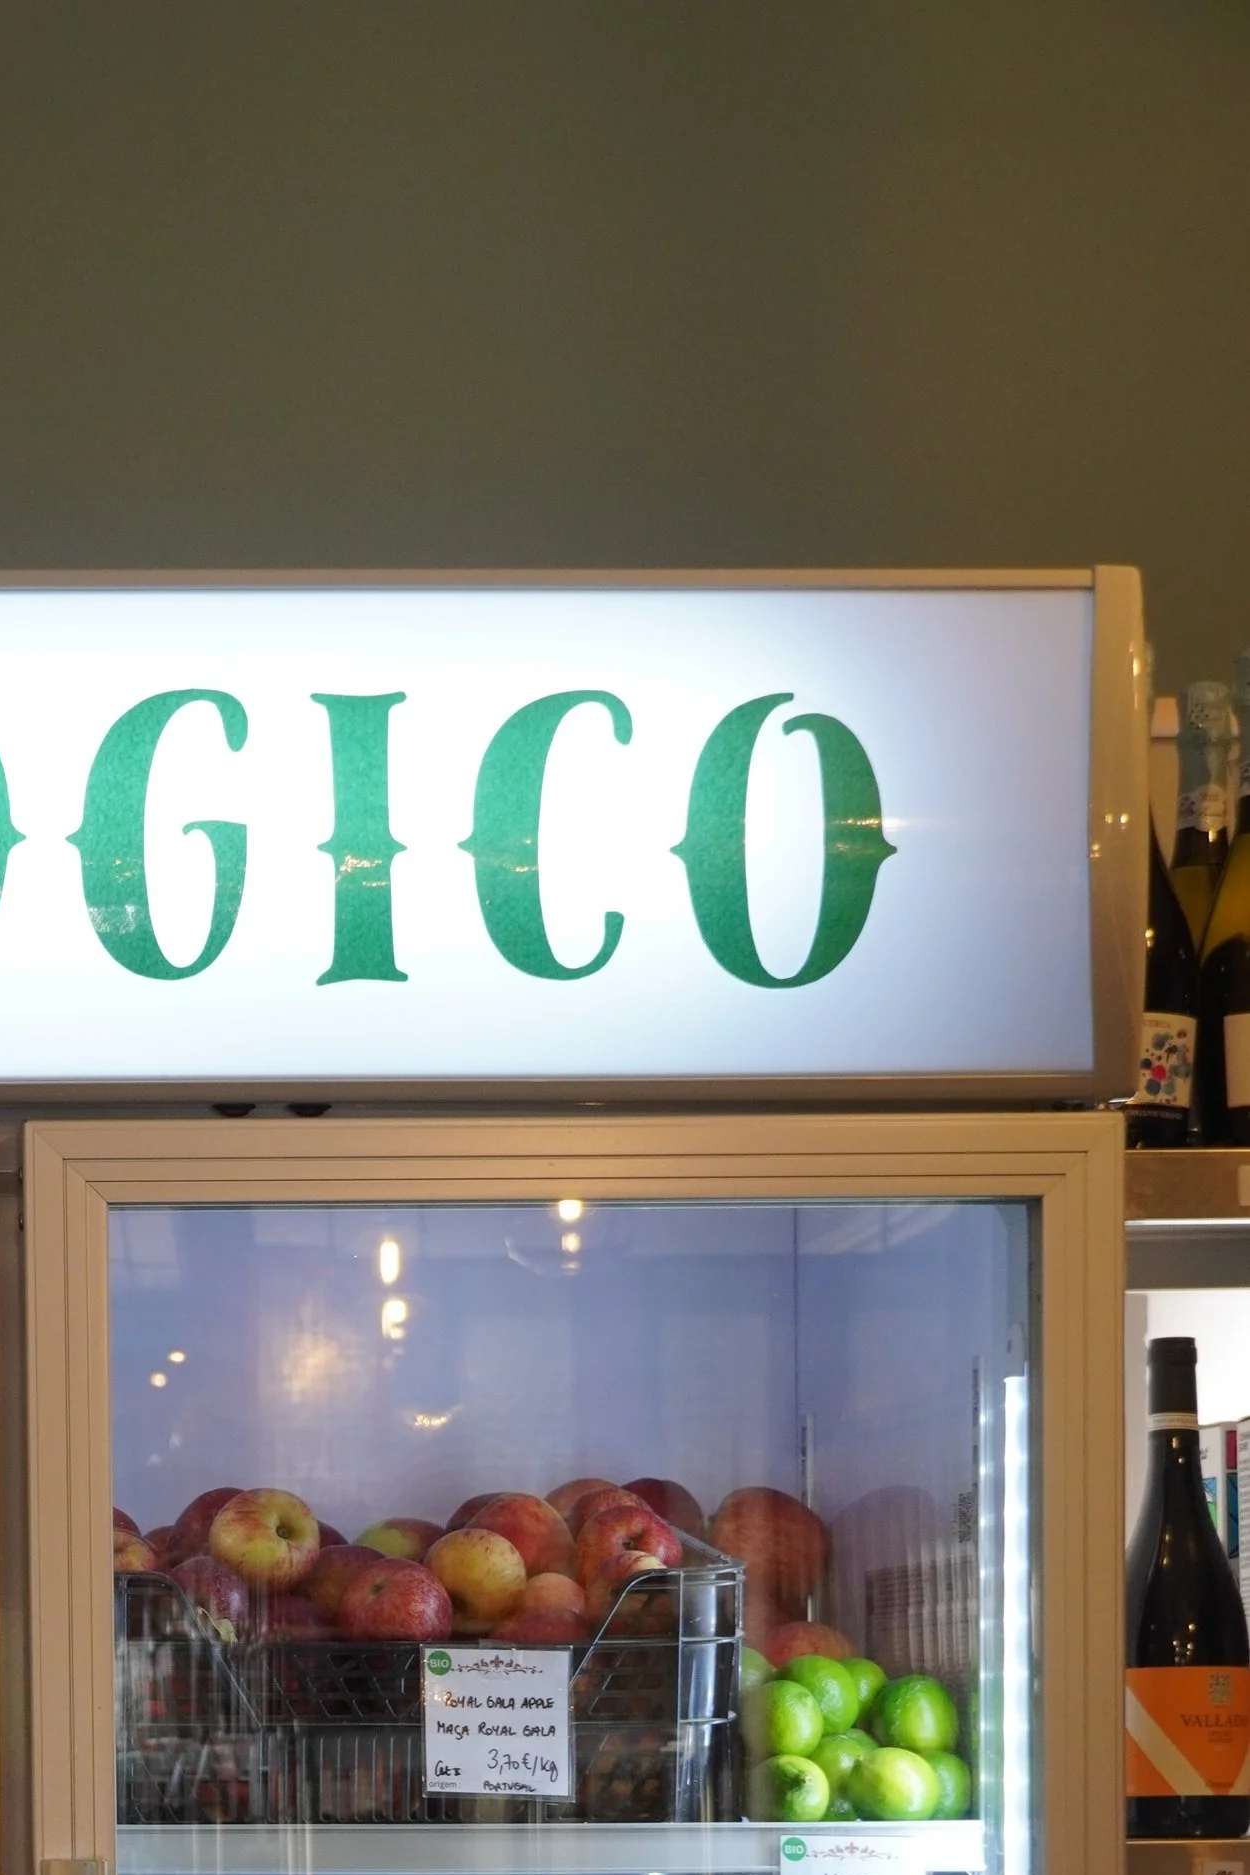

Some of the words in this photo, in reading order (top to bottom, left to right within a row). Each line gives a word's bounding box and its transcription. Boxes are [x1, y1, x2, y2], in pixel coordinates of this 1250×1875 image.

[430, 1659, 448, 1667] BIO
[487, 1696, 515, 1709] GALA
[521, 1698, 554, 1708] APPLE
[478, 1722, 516, 1736] ROYAL
[523, 1726, 555, 1736] GALA
[785, 1845, 804, 1853] BIO
